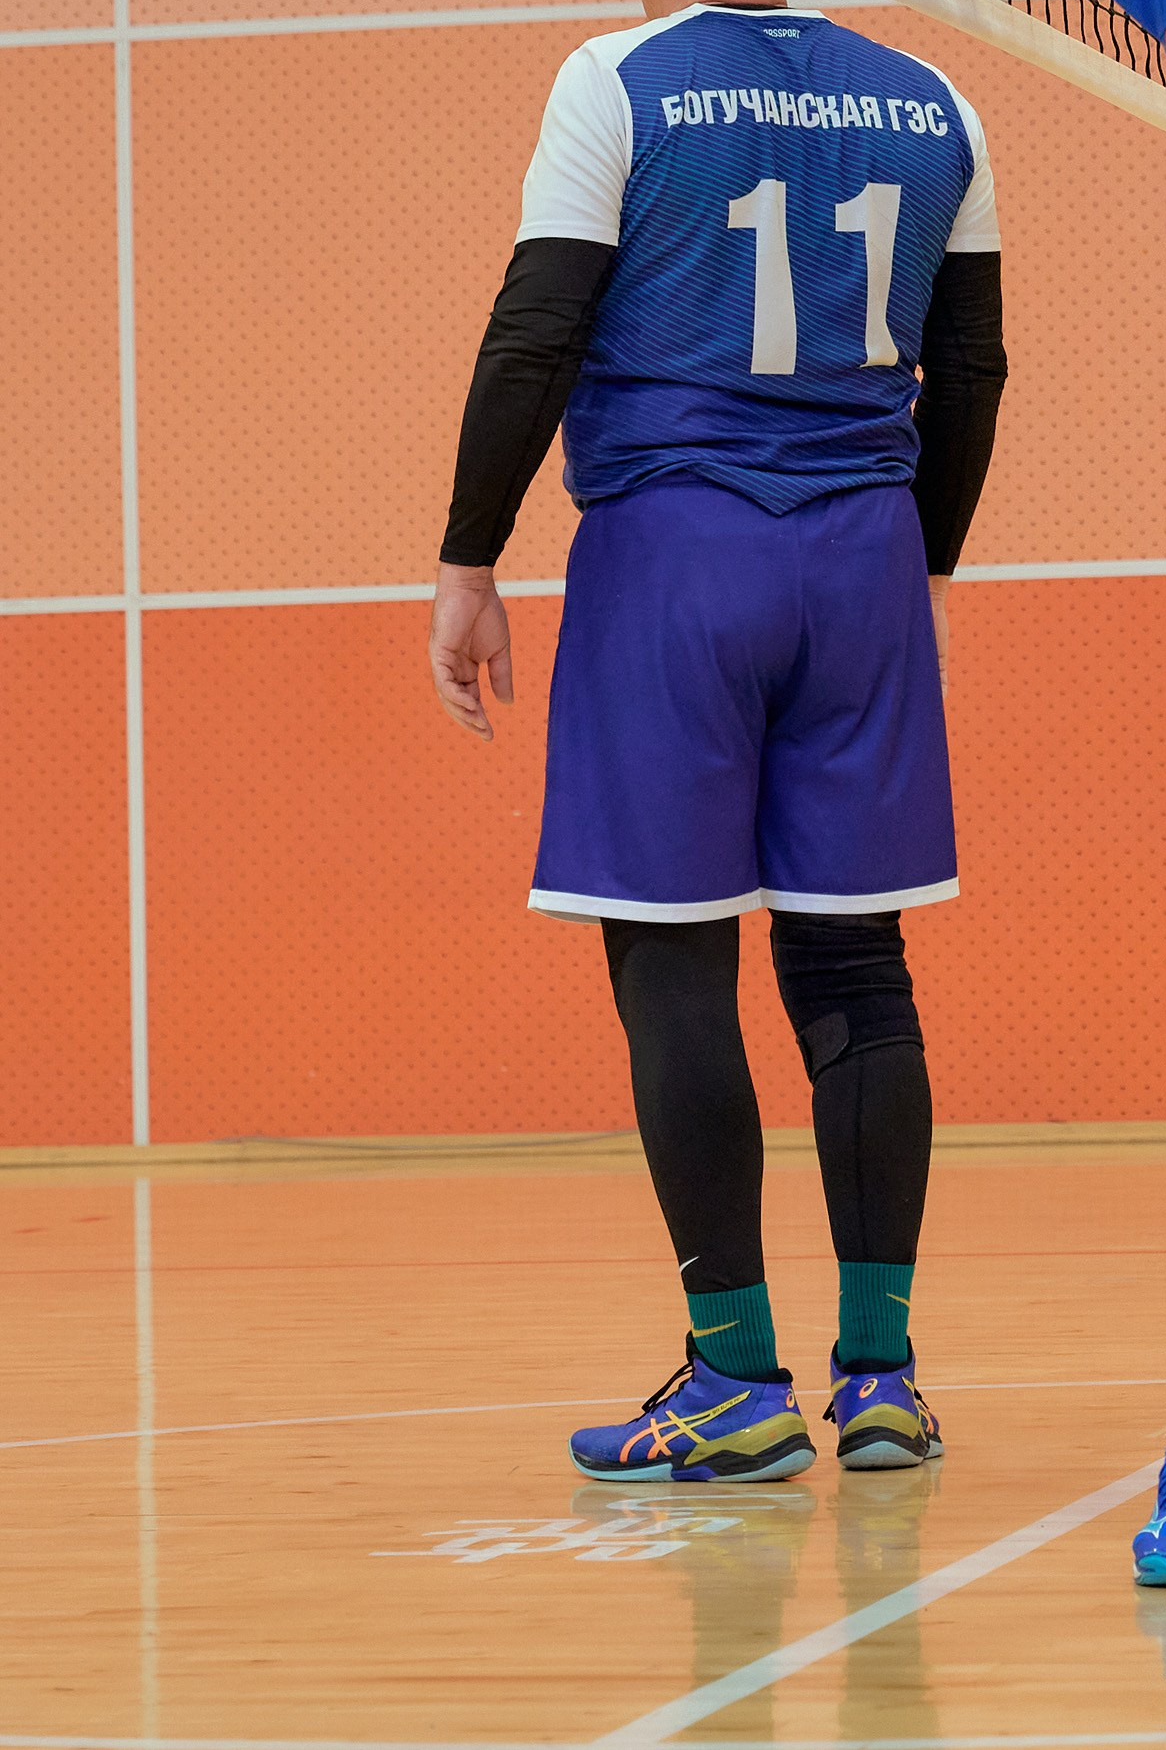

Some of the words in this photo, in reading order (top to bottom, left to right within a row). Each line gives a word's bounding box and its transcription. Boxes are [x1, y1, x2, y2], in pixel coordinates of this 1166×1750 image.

[661, 88, 884, 130] БОГУЧАНСКАЯ
[886, 98, 949, 137] ГЭС
[727, 178, 902, 375] 11
